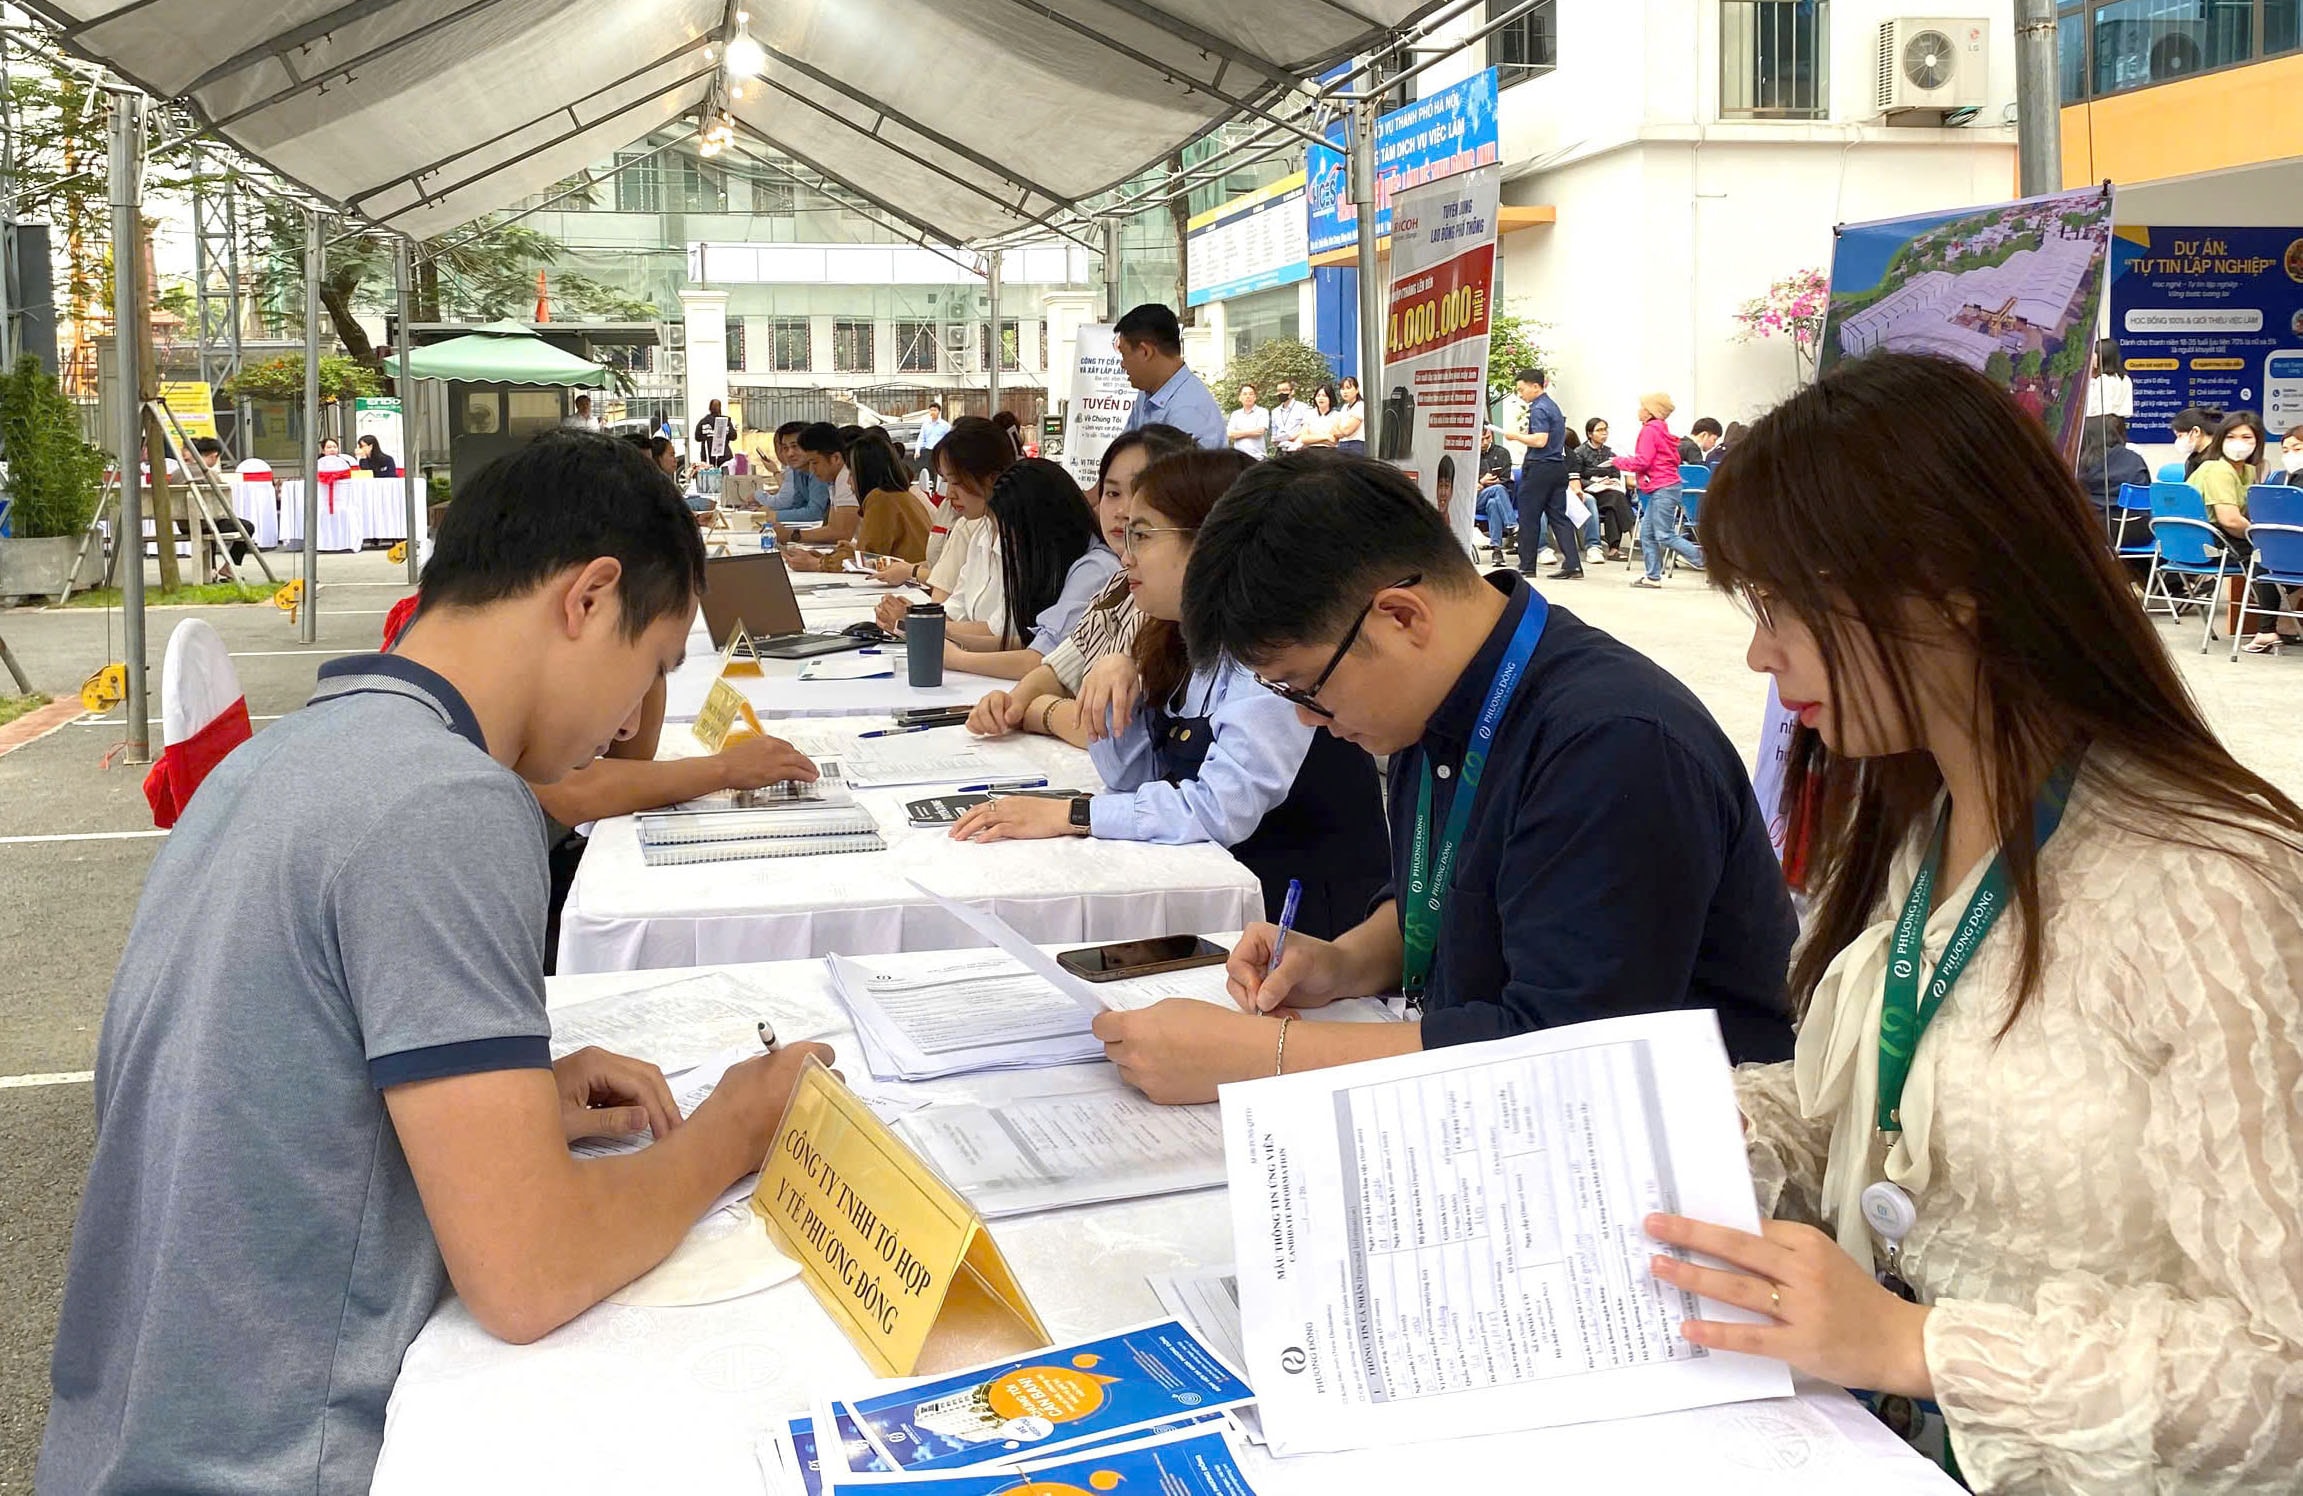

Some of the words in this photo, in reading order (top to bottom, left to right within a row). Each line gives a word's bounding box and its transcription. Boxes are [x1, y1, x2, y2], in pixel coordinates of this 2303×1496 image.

[1397, 138, 1415, 161] DỊCH
[1417, 132, 1427, 153] VỤ
[1429, 122, 1446, 148] VIỆC
[1448, 117, 1465, 138] LÀM
[1394, 217, 1418, 233] RICOH
[2174, 239, 2200, 259] DỰ
[2202, 238, 2228, 256] ÁN:
[2157, 258, 2180, 274] TIN
[2184, 257, 2211, 277] LẬP
[1080, 356, 1096, 365] CÔNG
[1098, 358, 1105, 366] TY
[1082, 394, 1120, 410] TUYỂN
[1092, 414, 1110, 424] Chúng
[1112, 415, 1122, 423] Tôi
[1896, 901, 1918, 955] PHƯƠNG
[1942, 925, 1975, 976] PHƯƠNG
[1967, 889, 1994, 928] ĐÔNG
[1279, 1147, 1292, 1210] INFORMATION
[785, 1127, 823, 1178] CÔNG
[823, 1162, 840, 1199] TY
[840, 1182, 876, 1242] TNHH
[877, 1225, 899, 1263] TỔ
[896, 1247, 932, 1298] HỢP
[1269, 1189, 1280, 1210] TIN
[1270, 1212, 1285, 1253] THÔNG
[1283, 1211, 1297, 1263] CANDIDATE
[777, 1176, 789, 1203] Y
[787, 1191, 805, 1224] TẾ
[801, 1206, 858, 1286] PHƯƠNG
[855, 1270, 899, 1336] ĐÔNG
[1355, 1283, 1366, 1308] NHÂN
[1361, 1324, 1369, 1339] TIN
[1364, 1342, 1376, 1377] THÔNG
